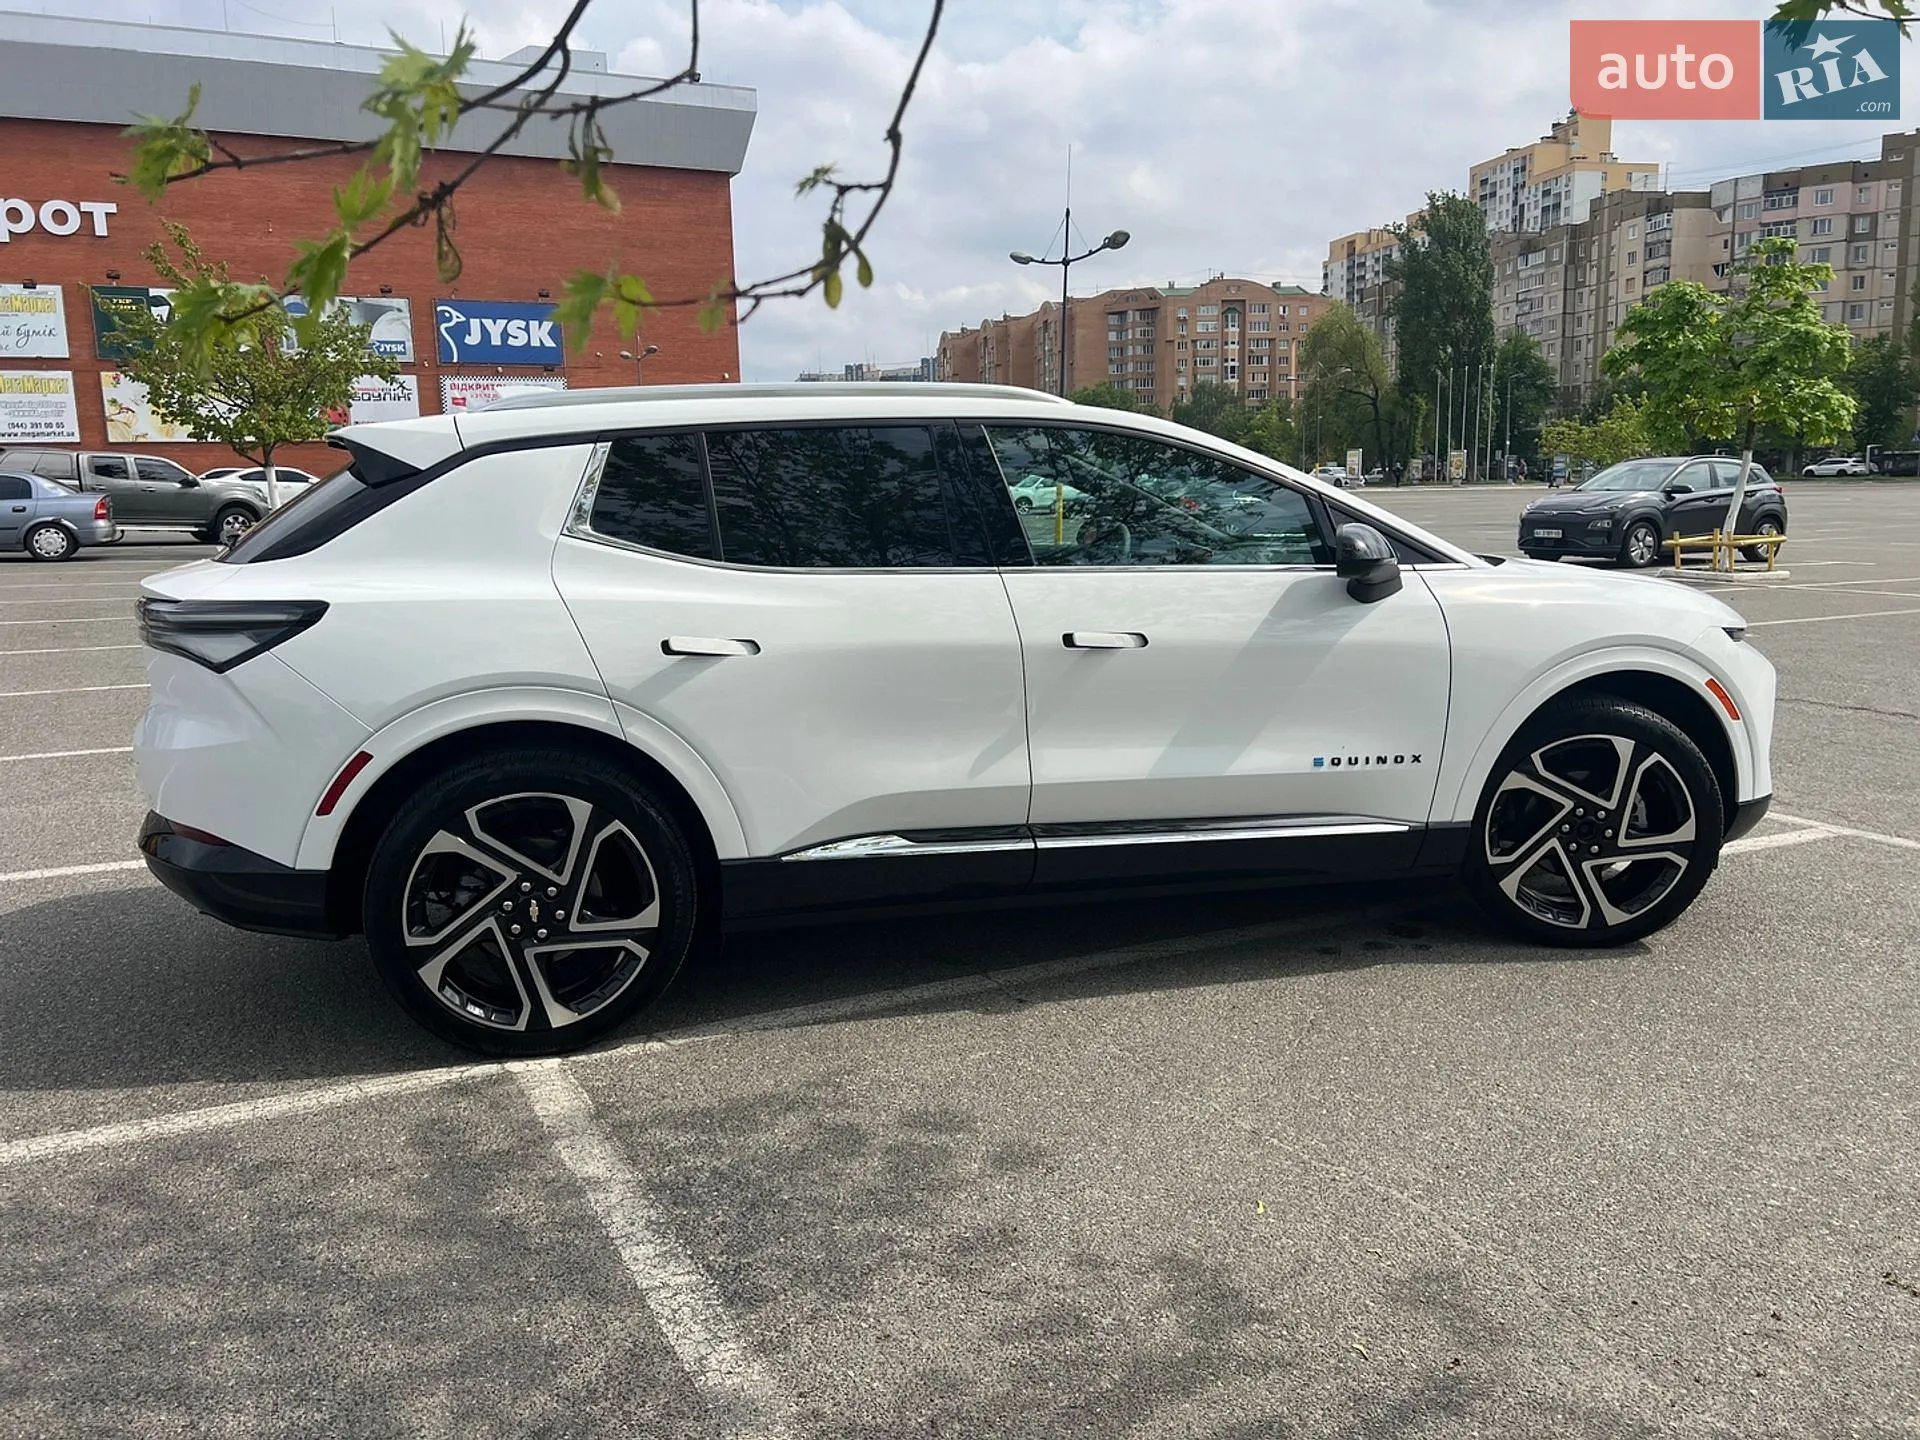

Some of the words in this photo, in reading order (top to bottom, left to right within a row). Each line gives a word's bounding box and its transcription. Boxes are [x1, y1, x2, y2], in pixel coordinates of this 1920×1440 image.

[16, 323, 57, 348] бутік
[464, 318, 557, 348] JYSK
[379, 343, 405, 352] JYSK
[449, 383, 504, 391] ВІДКРИТ
[8, 422, 27, 430] (044)
[1313, 754, 1422, 767] EQUINOX
